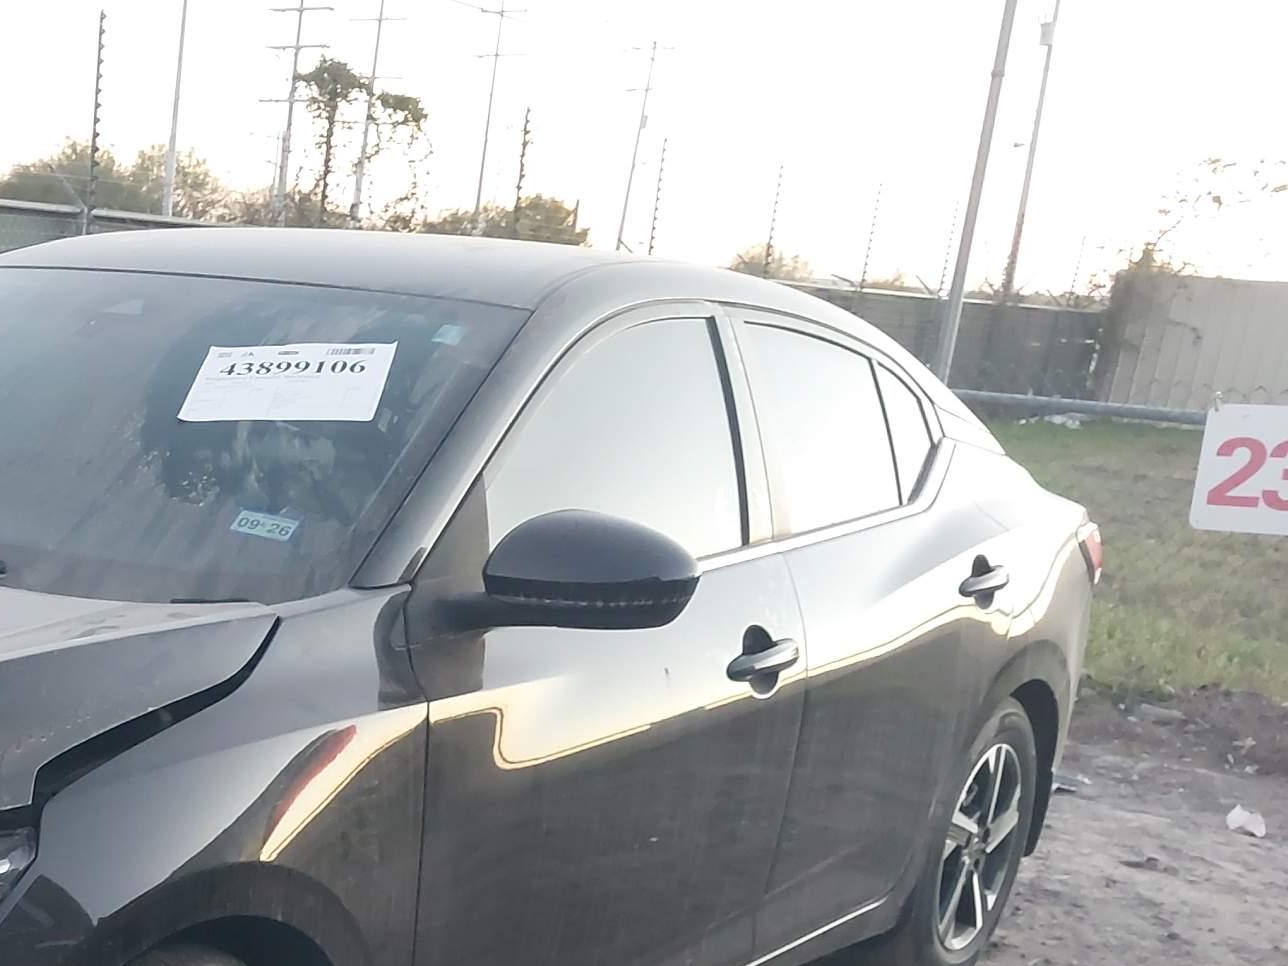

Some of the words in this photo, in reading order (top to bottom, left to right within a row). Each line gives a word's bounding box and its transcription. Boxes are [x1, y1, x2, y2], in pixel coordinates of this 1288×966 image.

[219, 359, 367, 376] 43899106
[237, 517, 260, 530] 09
[266, 523, 292, 537] 26
